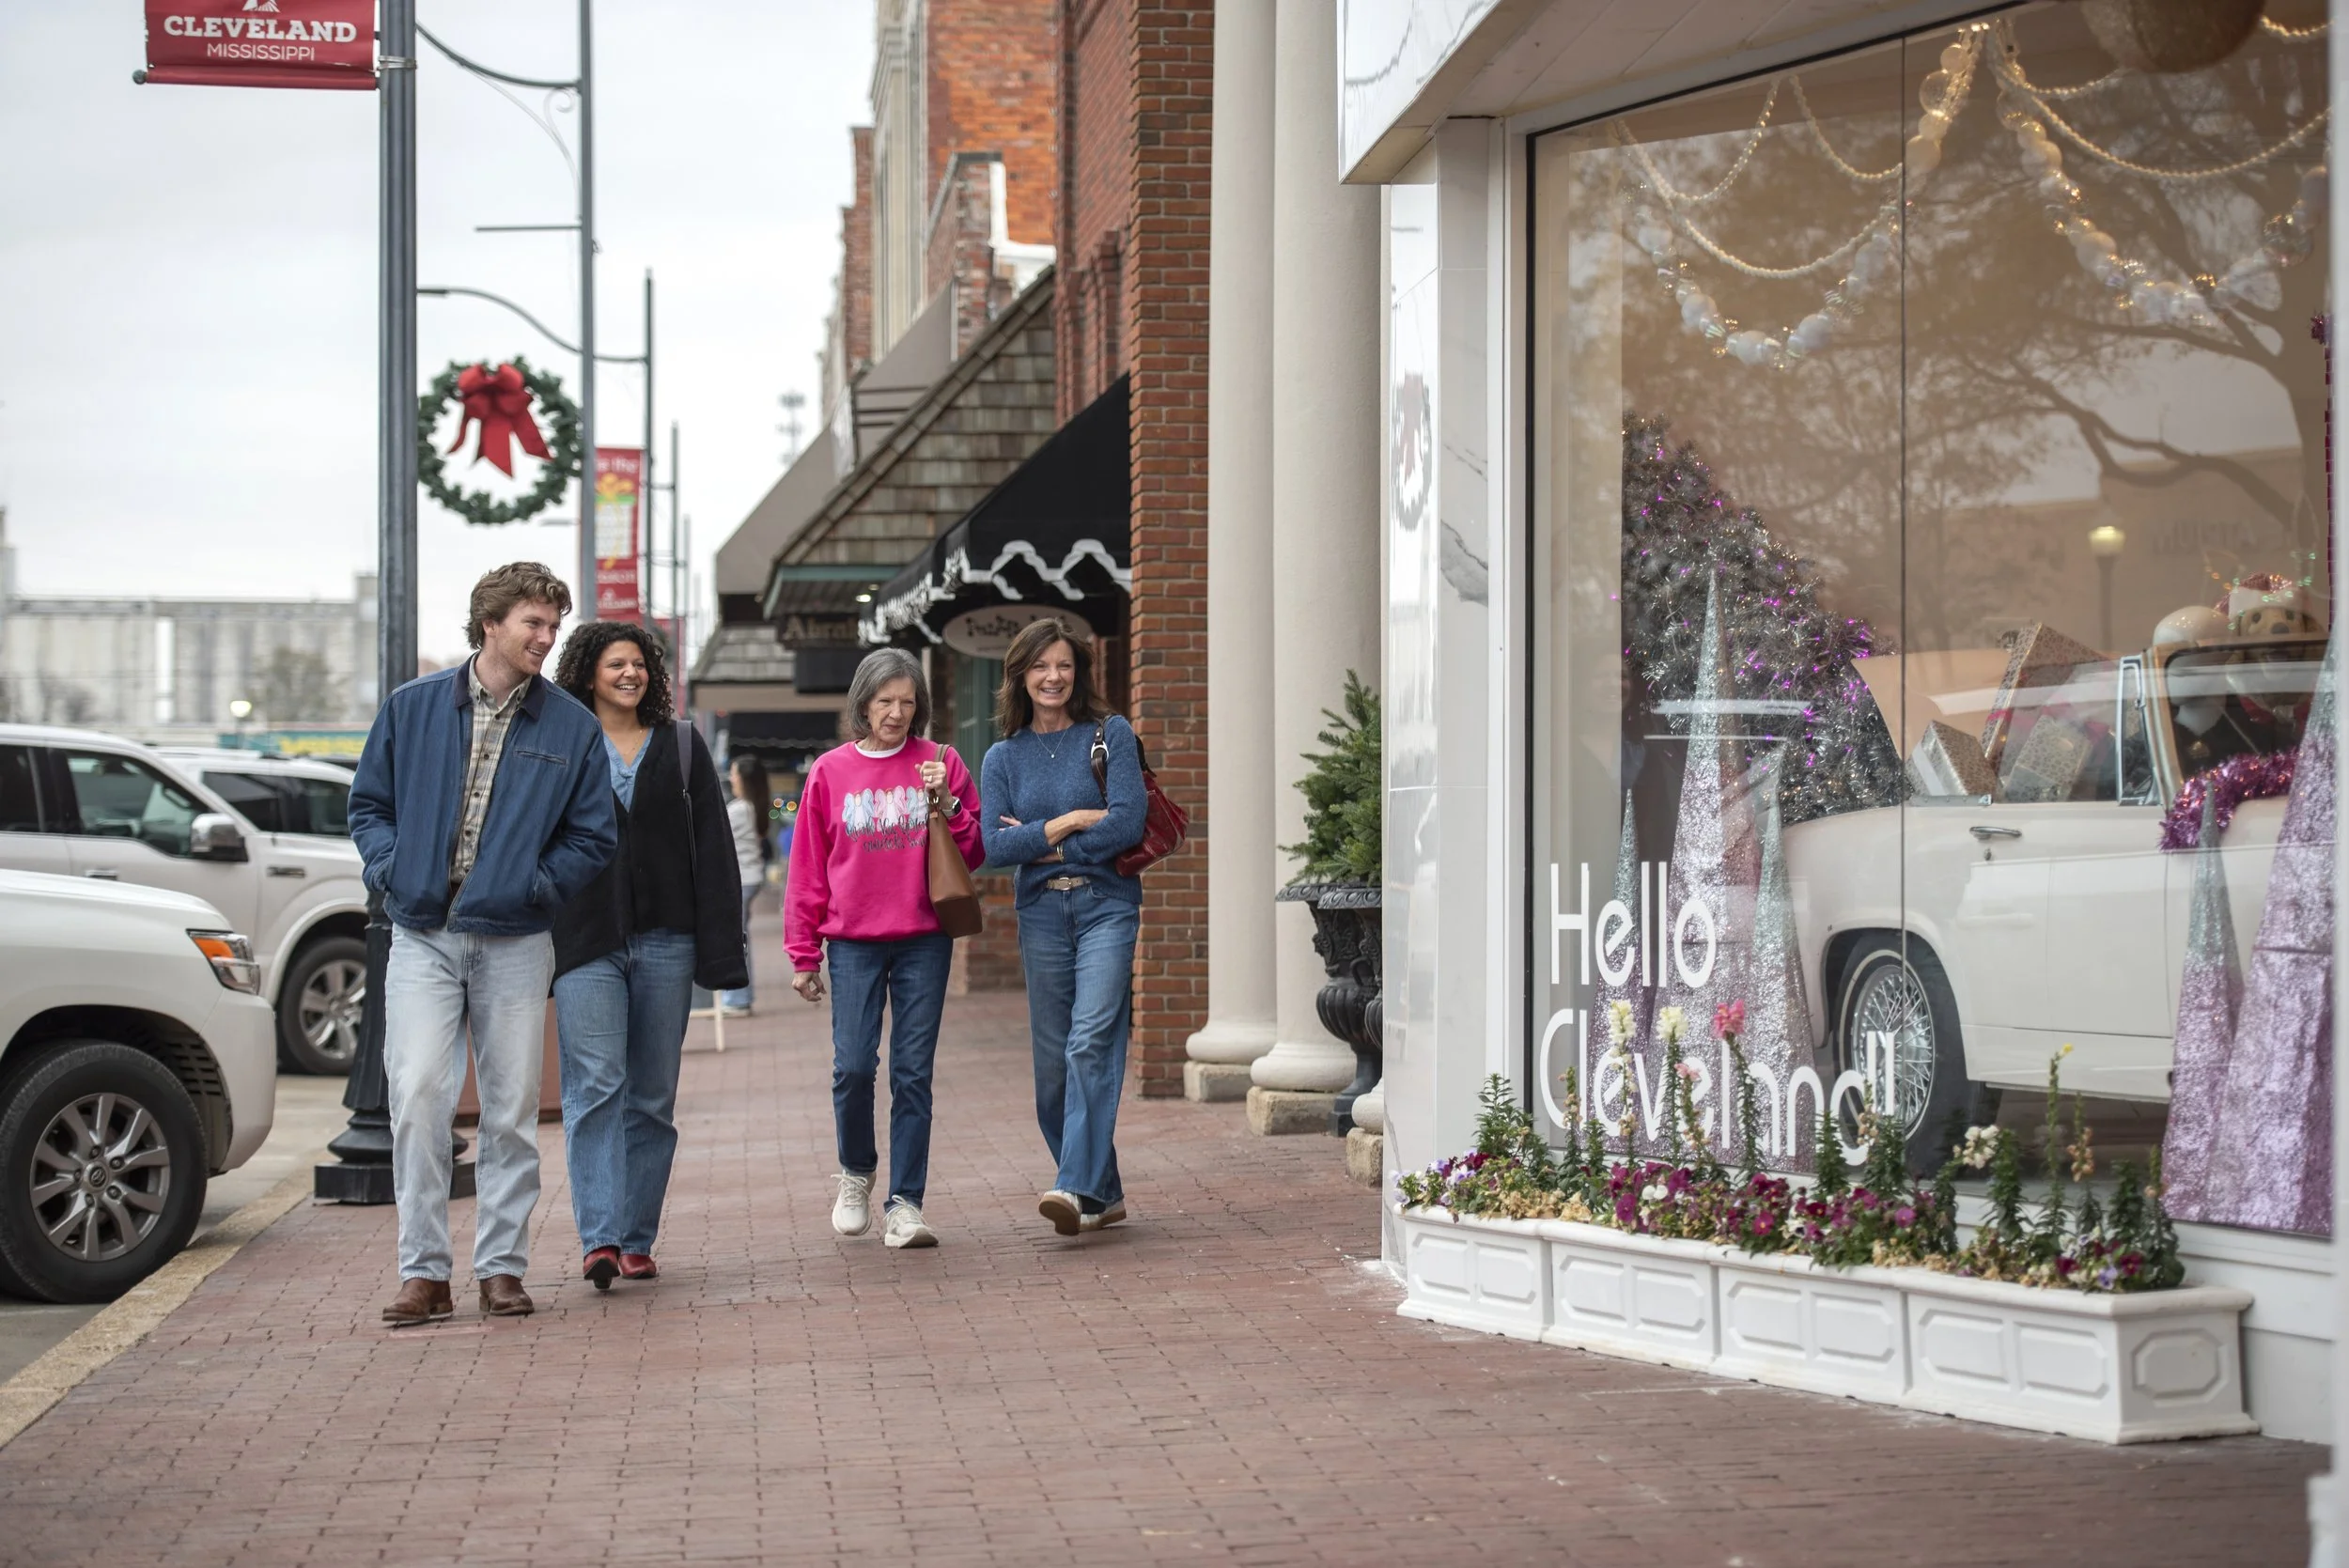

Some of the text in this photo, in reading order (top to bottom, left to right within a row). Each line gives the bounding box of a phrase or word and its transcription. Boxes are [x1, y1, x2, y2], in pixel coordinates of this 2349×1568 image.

[163, 15, 358, 43] CLEVELAND
[207, 43, 316, 61] MISSISSIPPI
[1550, 861, 1717, 988] Hello
